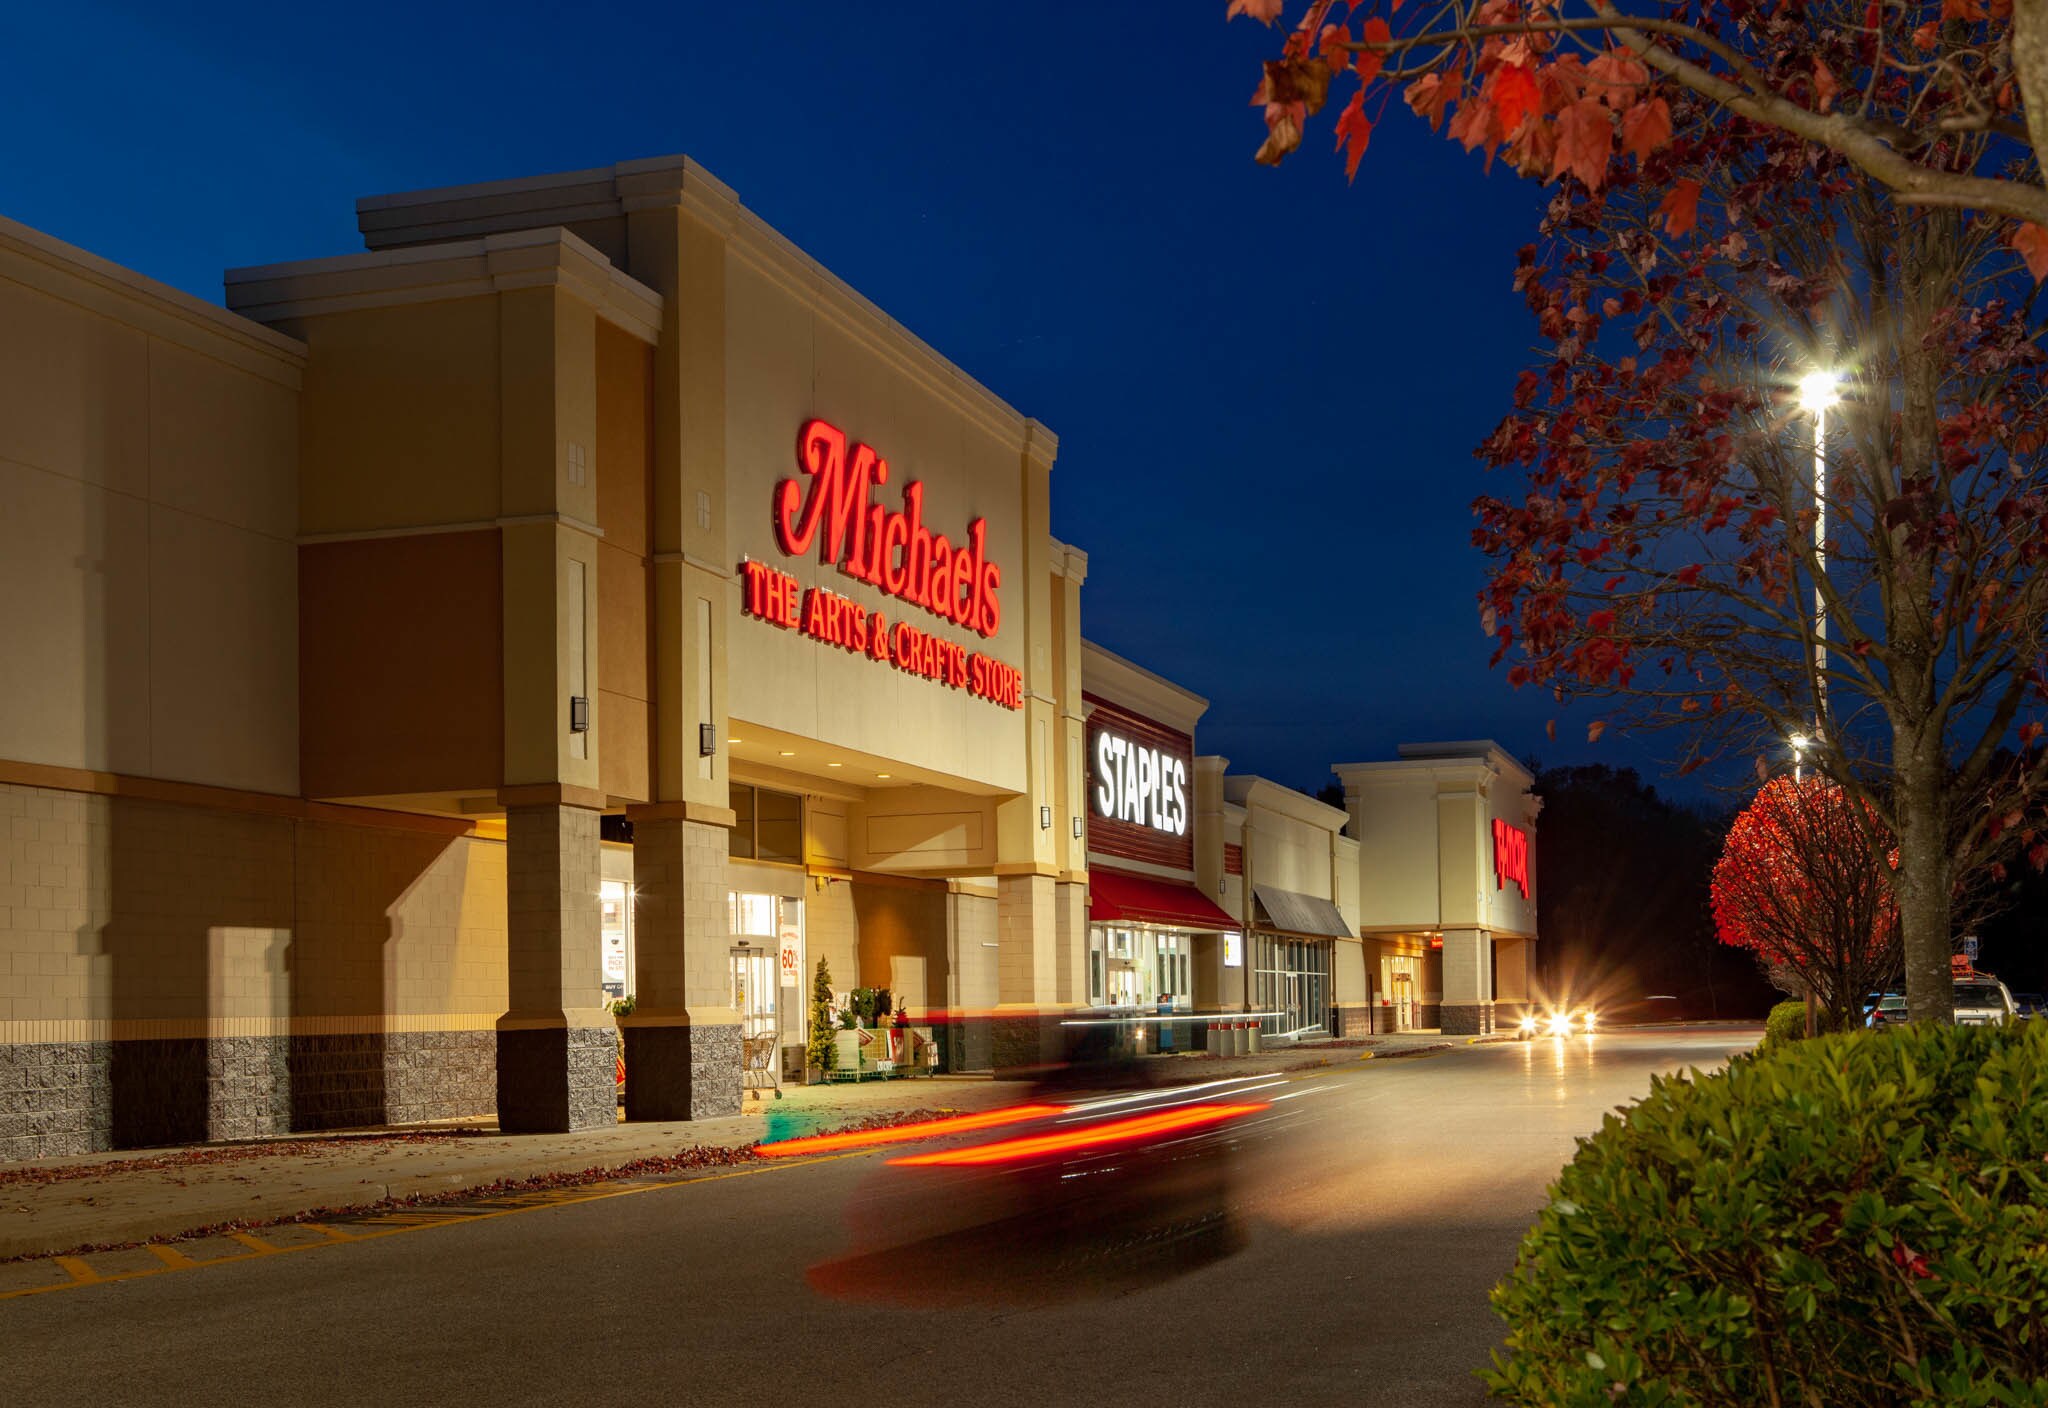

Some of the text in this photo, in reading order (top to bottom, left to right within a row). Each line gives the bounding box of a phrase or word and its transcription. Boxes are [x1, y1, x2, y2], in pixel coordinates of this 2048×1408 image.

[774, 419, 1000, 637] Michaels
[743, 560, 1023, 709] THE ARTS & CRAFTS STORE
[1098, 731, 1187, 836] STAPLES
